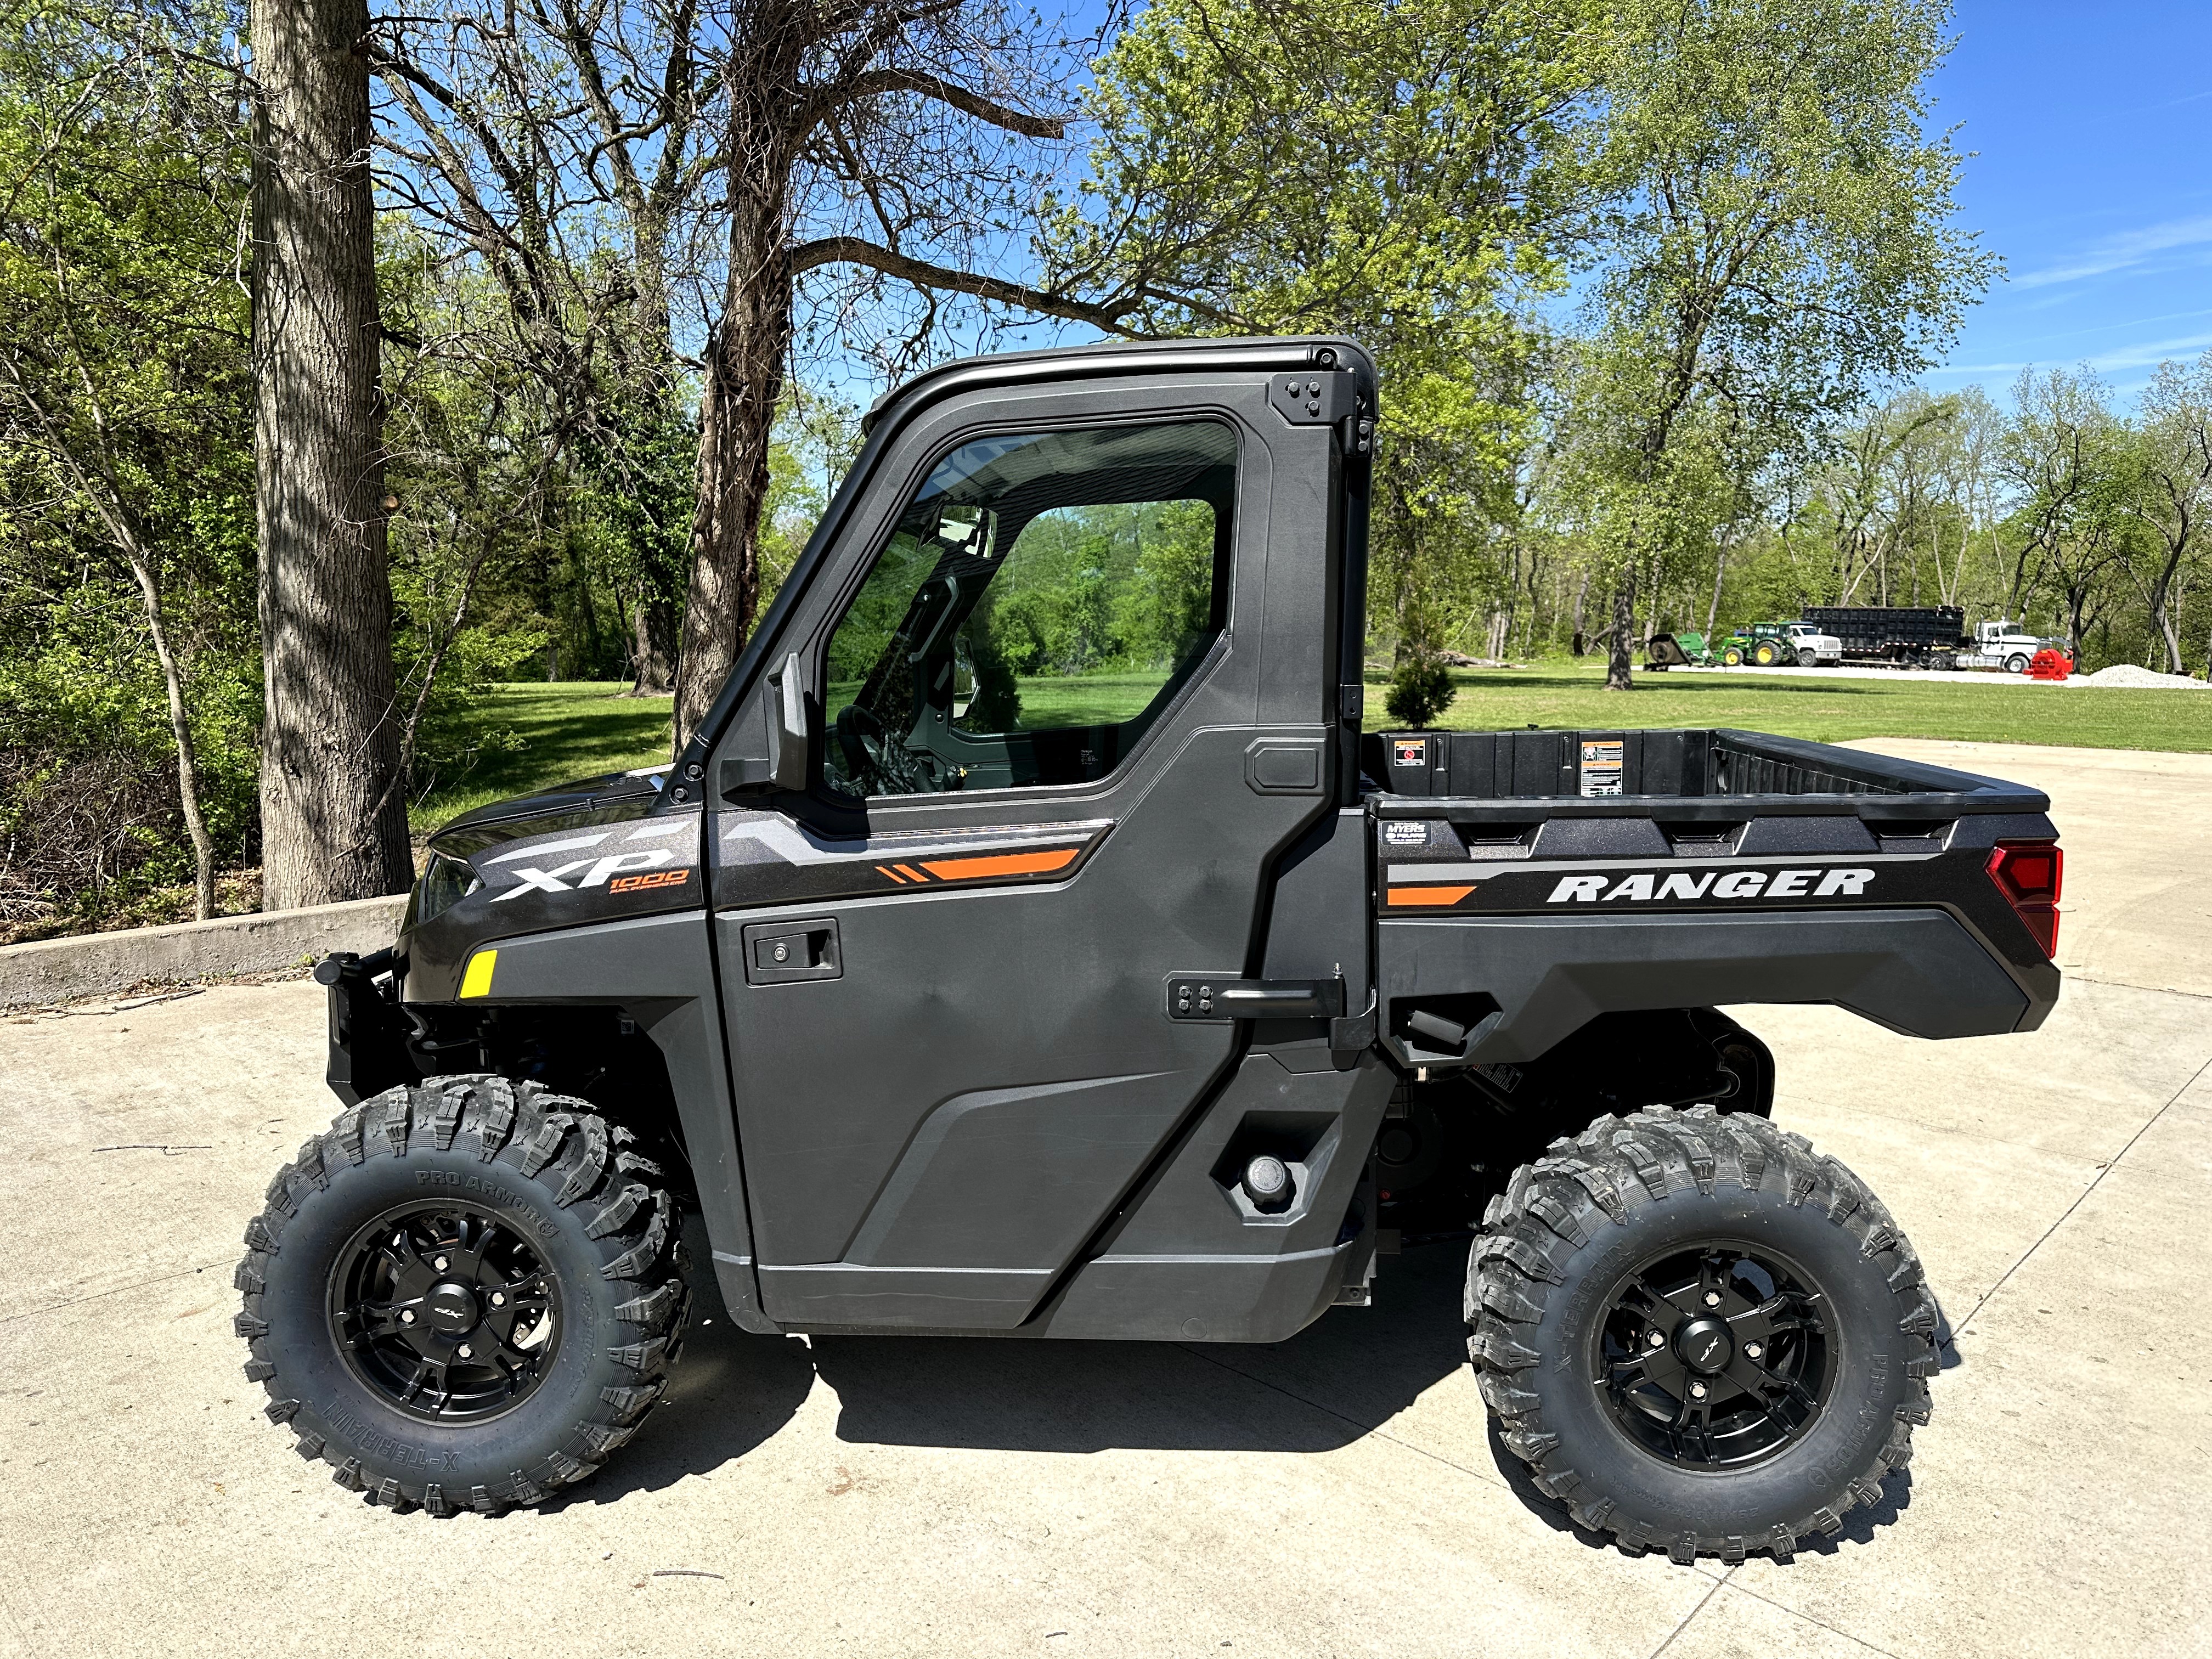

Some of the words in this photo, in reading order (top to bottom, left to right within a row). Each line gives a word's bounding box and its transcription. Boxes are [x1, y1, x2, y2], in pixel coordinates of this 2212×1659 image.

[1387, 825, 1425, 833] MYERS
[489, 849, 674, 902] XP
[610, 870, 689, 889] 1000
[1547, 868, 1875, 902] RANGER
[415, 1170, 461, 1186] PRO
[466, 1176, 541, 1223] ARMOR
[1553, 1239, 1635, 1374] X-TERRAIN
[1700, 1336, 1719, 1362] XP
[1868, 1354, 1889, 1400] PRO
[321, 1401, 461, 1472] X-TERRAIN
[1824, 1400, 1881, 1476] ARMOR
